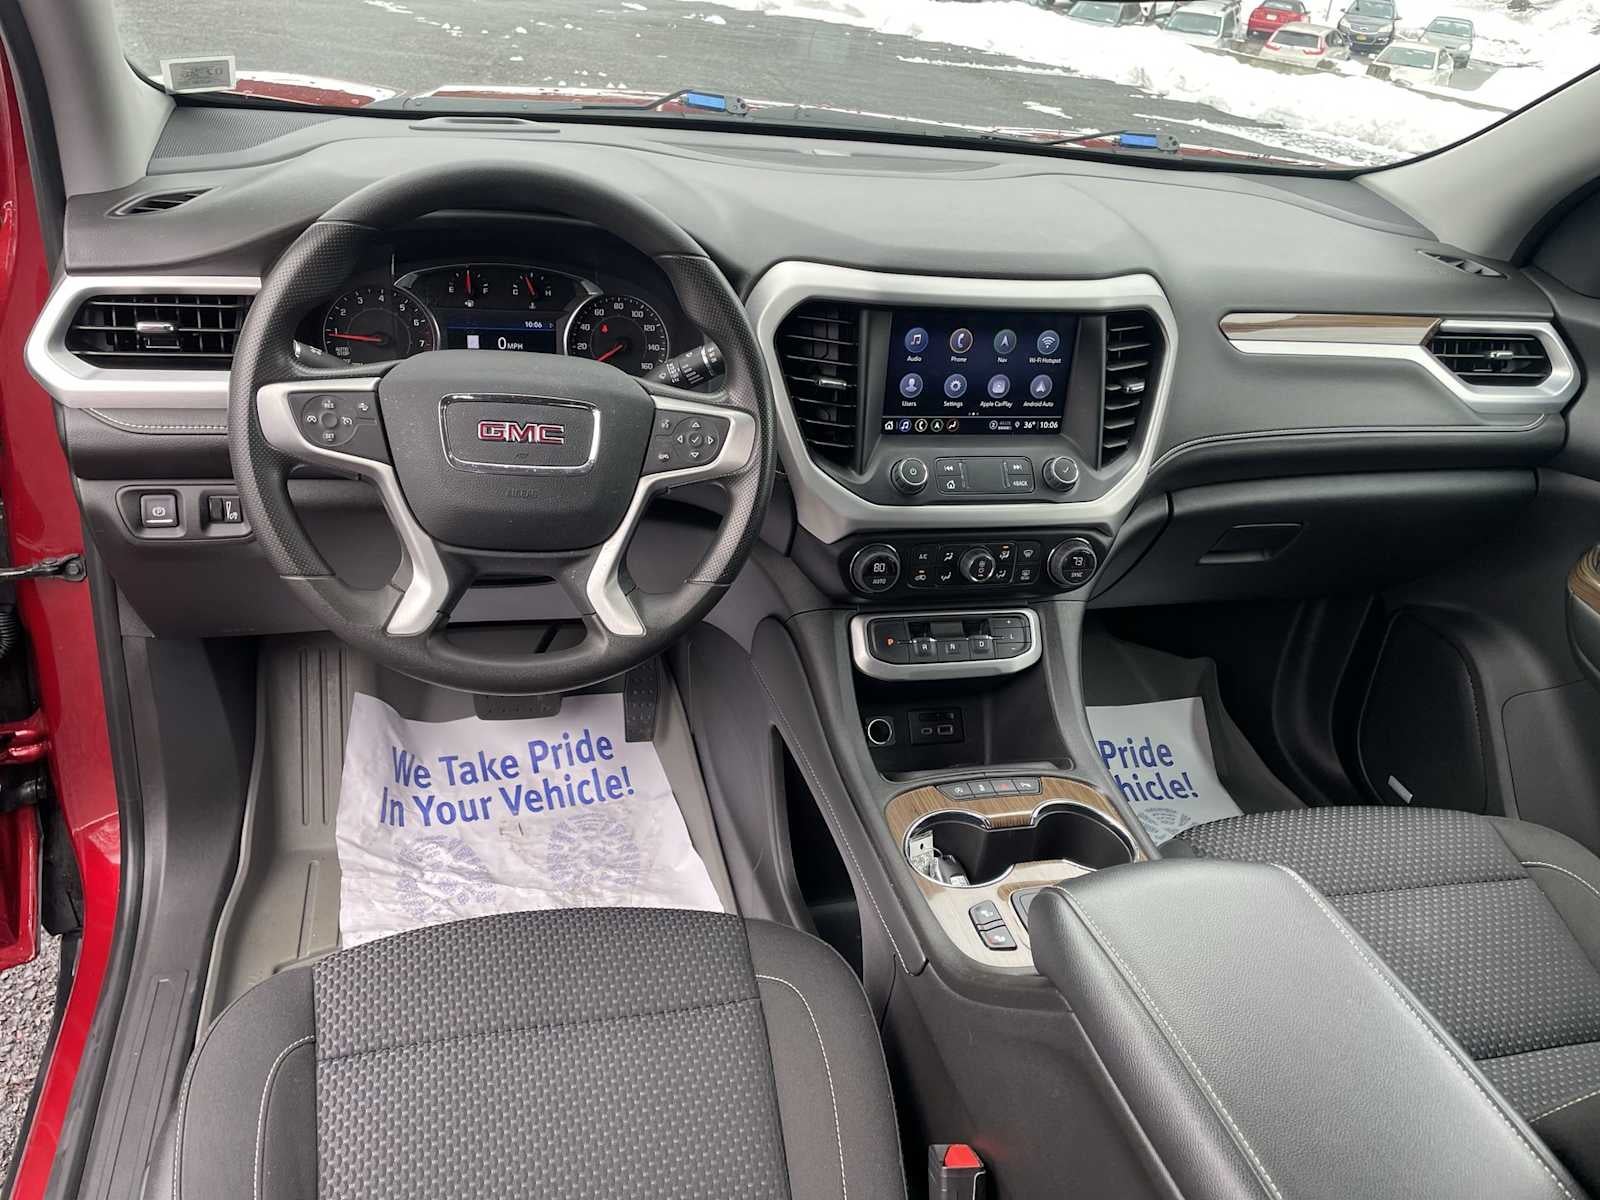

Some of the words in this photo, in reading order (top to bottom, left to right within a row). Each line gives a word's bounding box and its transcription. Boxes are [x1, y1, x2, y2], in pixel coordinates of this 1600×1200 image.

[378, 294, 385, 302] 4
[613, 302, 624, 310] 80
[631, 310, 644, 318] 100
[524, 321, 543, 329] 10:06
[580, 323, 591, 331] 40
[643, 324, 656, 332] 120
[497, 336, 507, 350] 0
[507, 342, 524, 350] MPH
[640, 362, 653, 370] 160
[943, 400, 964, 408] Settings
[994, 401, 1013, 409] CarPlay
[1040, 421, 1059, 429] 10:06
[478, 420, 565, 445] GMC
[887, 638, 894, 646] P
[1098, 737, 1174, 769] Pride
[392, 746, 432, 789] We
[438, 751, 520, 786] Take
[528, 728, 614, 774] Pride
[1114, 772, 1199, 801] hicle!
[380, 787, 405, 827] In
[412, 795, 492, 827] Your
[499, 766, 635, 816] Vehicle!
